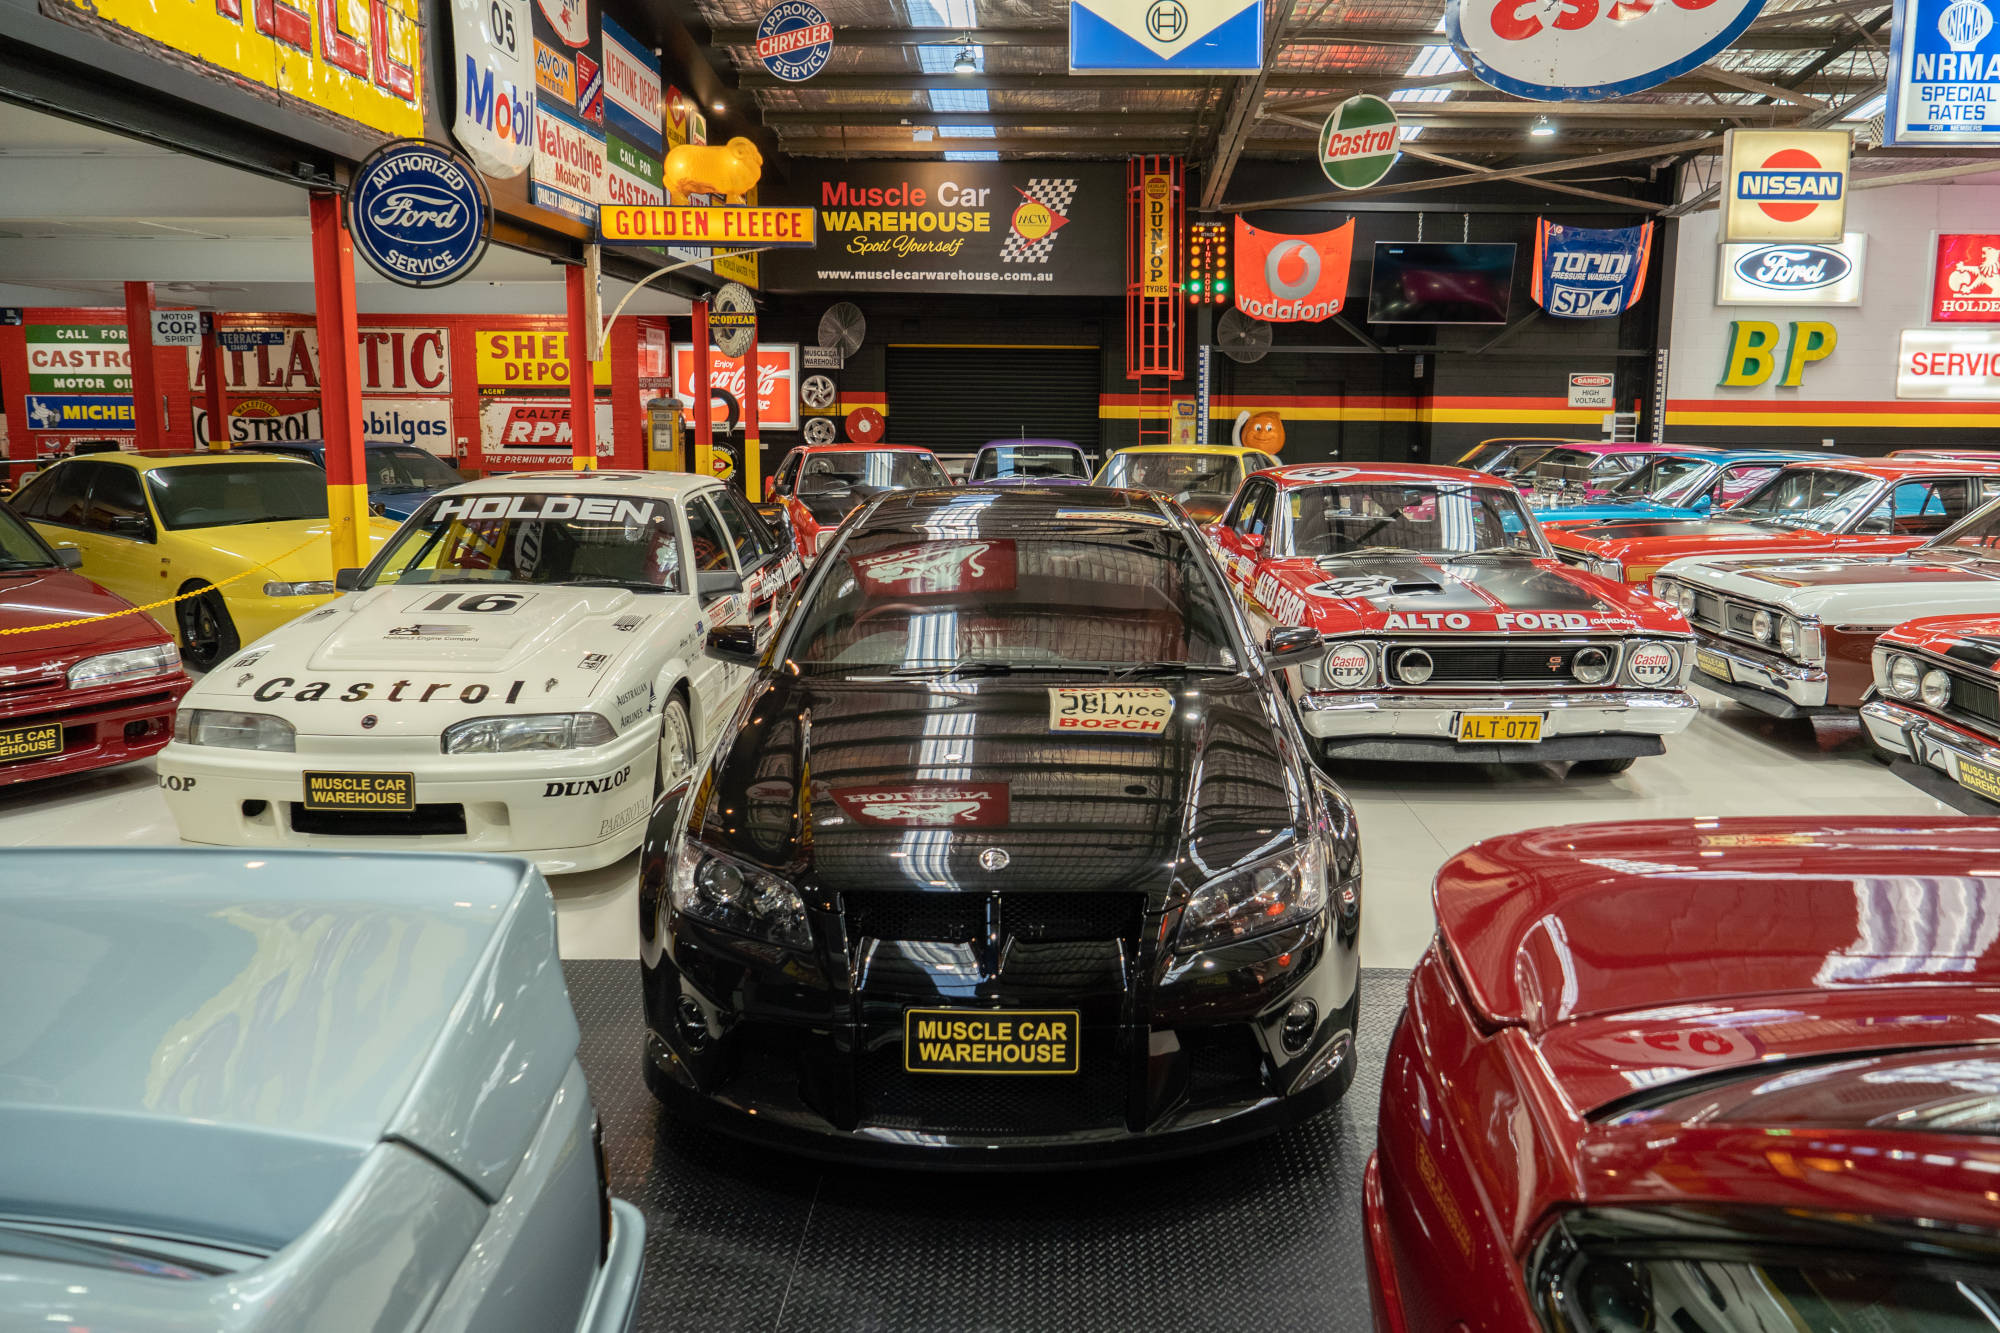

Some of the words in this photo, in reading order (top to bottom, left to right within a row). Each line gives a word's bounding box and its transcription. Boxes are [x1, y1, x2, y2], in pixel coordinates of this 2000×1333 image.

[491, 0, 516, 53] 05
[763, 3, 821, 35] APPROVED
[1948, 5, 1982, 44] NRMA
[759, 25, 829, 55] CHRYSLER
[537, 50, 569, 83] AVON
[773, 48, 826, 78] SERVICE
[1915, 53, 2000, 80] NRMA
[543, 75, 564, 96] TYRES
[605, 49, 637, 103] NEPTUNE
[640, 76, 659, 118] DEPOT
[1921, 86, 1996, 102] SPECIAL
[466, 53, 533, 147] Mobil
[1928, 105, 1985, 120] RATES
[536, 115, 602, 178] Valvoline
[1327, 126, 1397, 158] Castrol
[372, 156, 464, 191] AUTHORIZED
[620, 148, 635, 168] CALL
[639, 159, 651, 177] FOR
[555, 163, 580, 189] Motor
[580, 174, 591, 195] Oil
[1742, 175, 1838, 196] NISSAN
[822, 181, 926, 207] Muscle
[937, 182, 990, 207] Car
[374, 193, 460, 229] Ford
[616, 209, 708, 236] GOLDEN
[724, 211, 802, 237] FLEECE
[822, 212, 990, 232] WAREHOUSE
[847, 235, 890, 255] Spoil
[892, 235, 964, 257] Yourself
[1150, 201, 1164, 282] DUNLOP
[386, 249, 455, 273] SERVICE
[1756, 250, 1825, 283] Ford
[817, 269, 1053, 282] www.musclecarwarehouse.com.au
[1551, 272, 1587, 281] PRESSURE
[1146, 285, 1168, 293] TYRES
[1239, 295, 1340, 320] vodafone
[1554, 290, 1591, 314] SP
[157, 321, 197, 334] COR
[709, 315, 756, 325] GOODYEAR
[56, 330, 88, 339] CALL
[101, 330, 127, 339] FOR
[165, 335, 194, 343] SPIRIT
[222, 333, 262, 344] TERRACE
[714, 360, 734, 369] Enjoy
[1718, 321, 1837, 387] BP
[53, 378, 105, 388] MOTOR
[236, 400, 278, 415] WAKEFIELD
[432, 496, 654, 524] HOLDEN
[423, 593, 524, 612] 16
[1254, 571, 1280, 610] ALTO
[1271, 586, 1306, 627] FORD
[1384, 613, 1471, 630] ALTO
[1496, 613, 1588, 630] FORD
[1331, 655, 1366, 668] Castrol
[1332, 667, 1364, 677] GTX
[1634, 654, 1669, 667] Castrol
[1634, 665, 1667, 676] GTX
[254, 677, 525, 704] Castrol
[616, 682, 648, 707] AUSTRALIAN
[620, 707, 643, 729] AIRLINES
[27, 729, 56, 741] CAR
[311, 777, 371, 790] MUSCLE
[374, 778, 406, 791] CAR
[543, 766, 631, 798] DUNLOP
[1960, 760, 1996, 784] MUSCLE
[312, 791, 407, 804] WAREHOUSE
[600, 795, 650, 836] PARKROYAL
[918, 1021, 1012, 1040] MUSCLE
[1018, 1022, 1067, 1041] CAR
[919, 1042, 1066, 1063] WAREHOUSE
